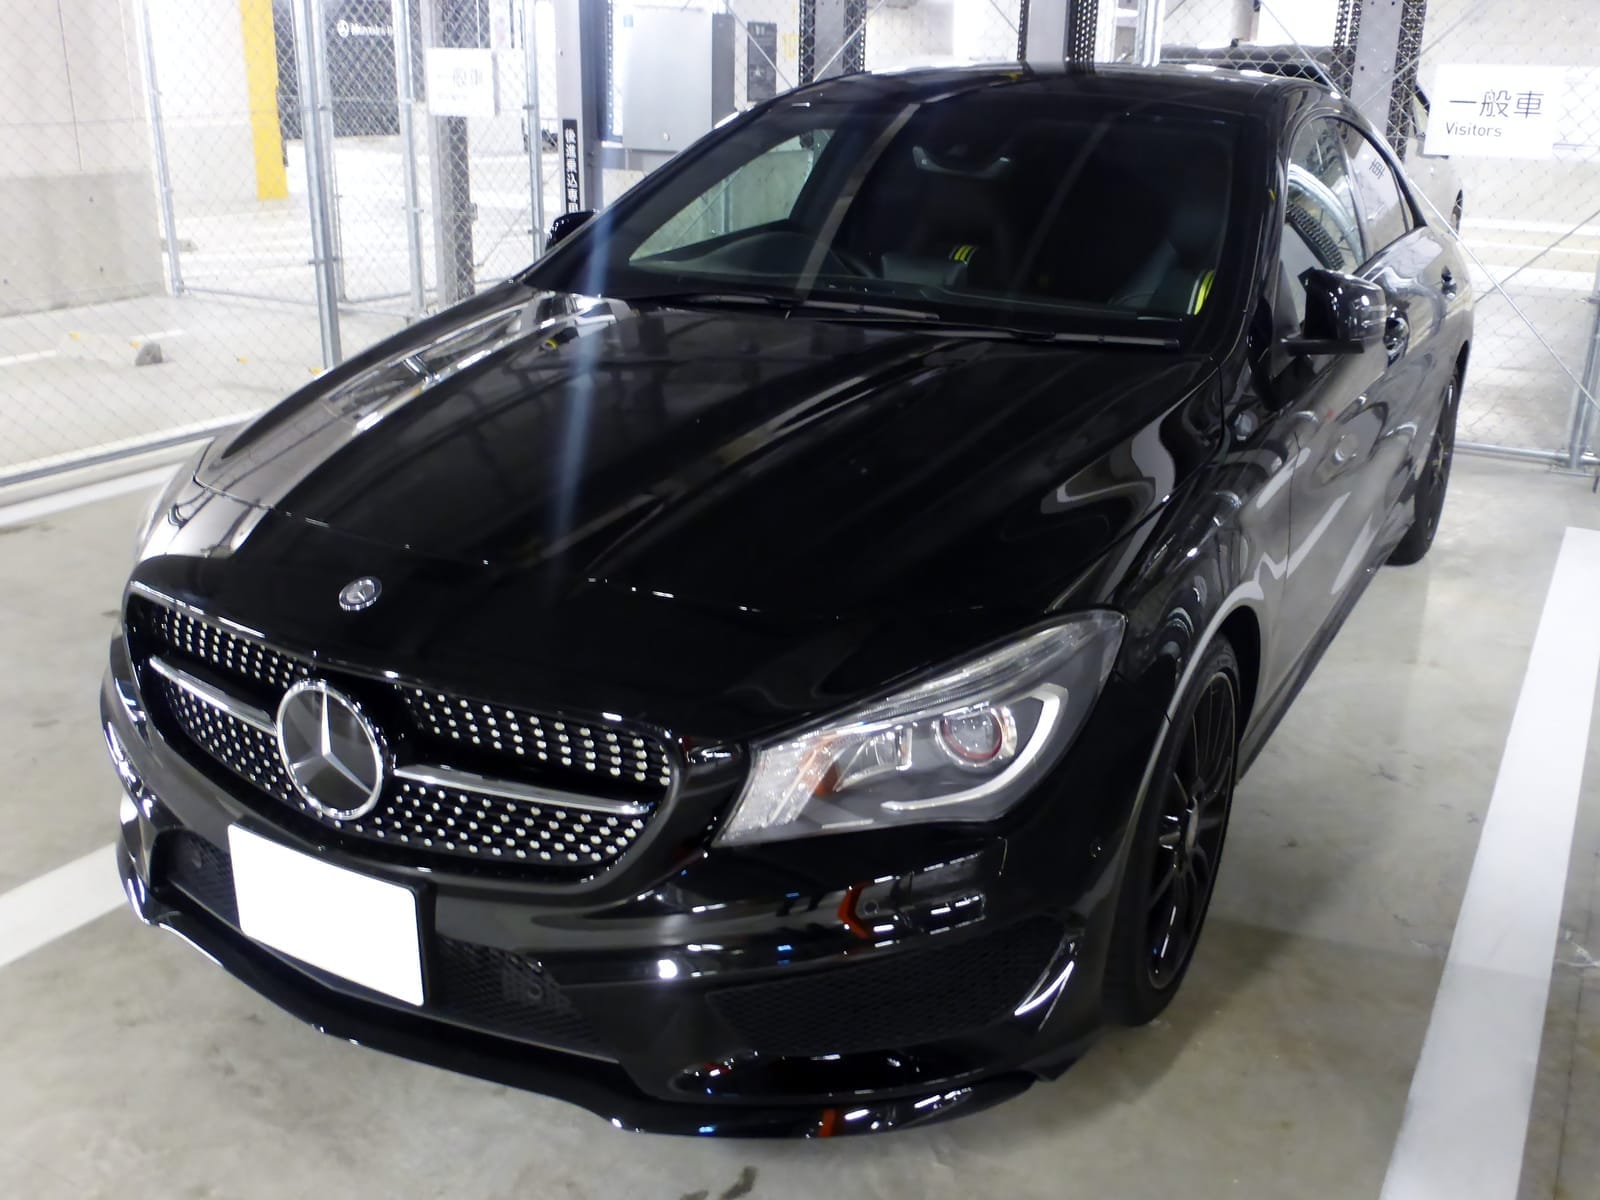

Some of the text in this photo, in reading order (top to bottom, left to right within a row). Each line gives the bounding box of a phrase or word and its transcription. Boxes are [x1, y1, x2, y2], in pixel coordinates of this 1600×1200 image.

[1449, 89, 1544, 118] 一般車
[1446, 122, 1502, 137] Visitors
